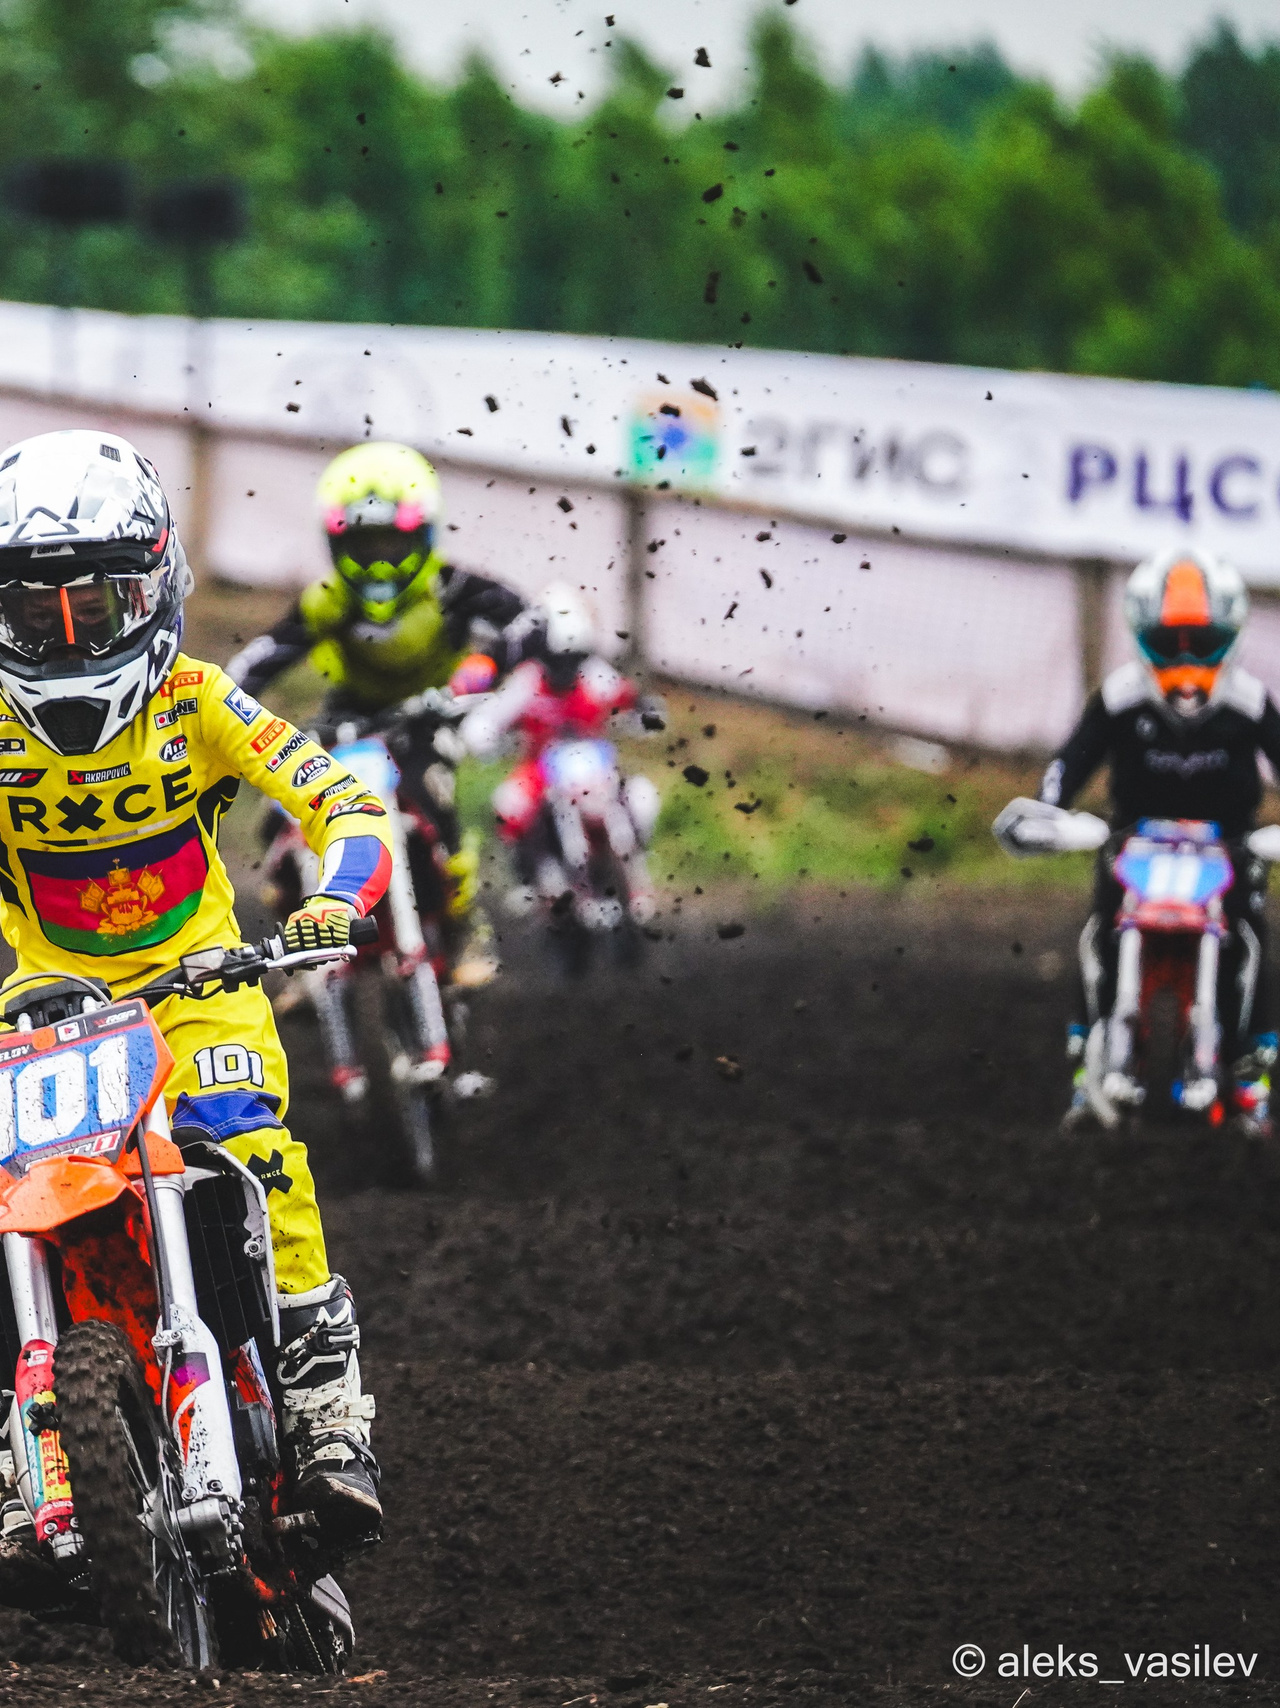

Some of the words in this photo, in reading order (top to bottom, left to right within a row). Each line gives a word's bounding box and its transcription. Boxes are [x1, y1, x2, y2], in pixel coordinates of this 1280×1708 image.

[1066, 442, 1280, 522] РЦС
[85, 763, 129, 783] AKRAPOVIC
[194, 1044, 265, 1089] 101
